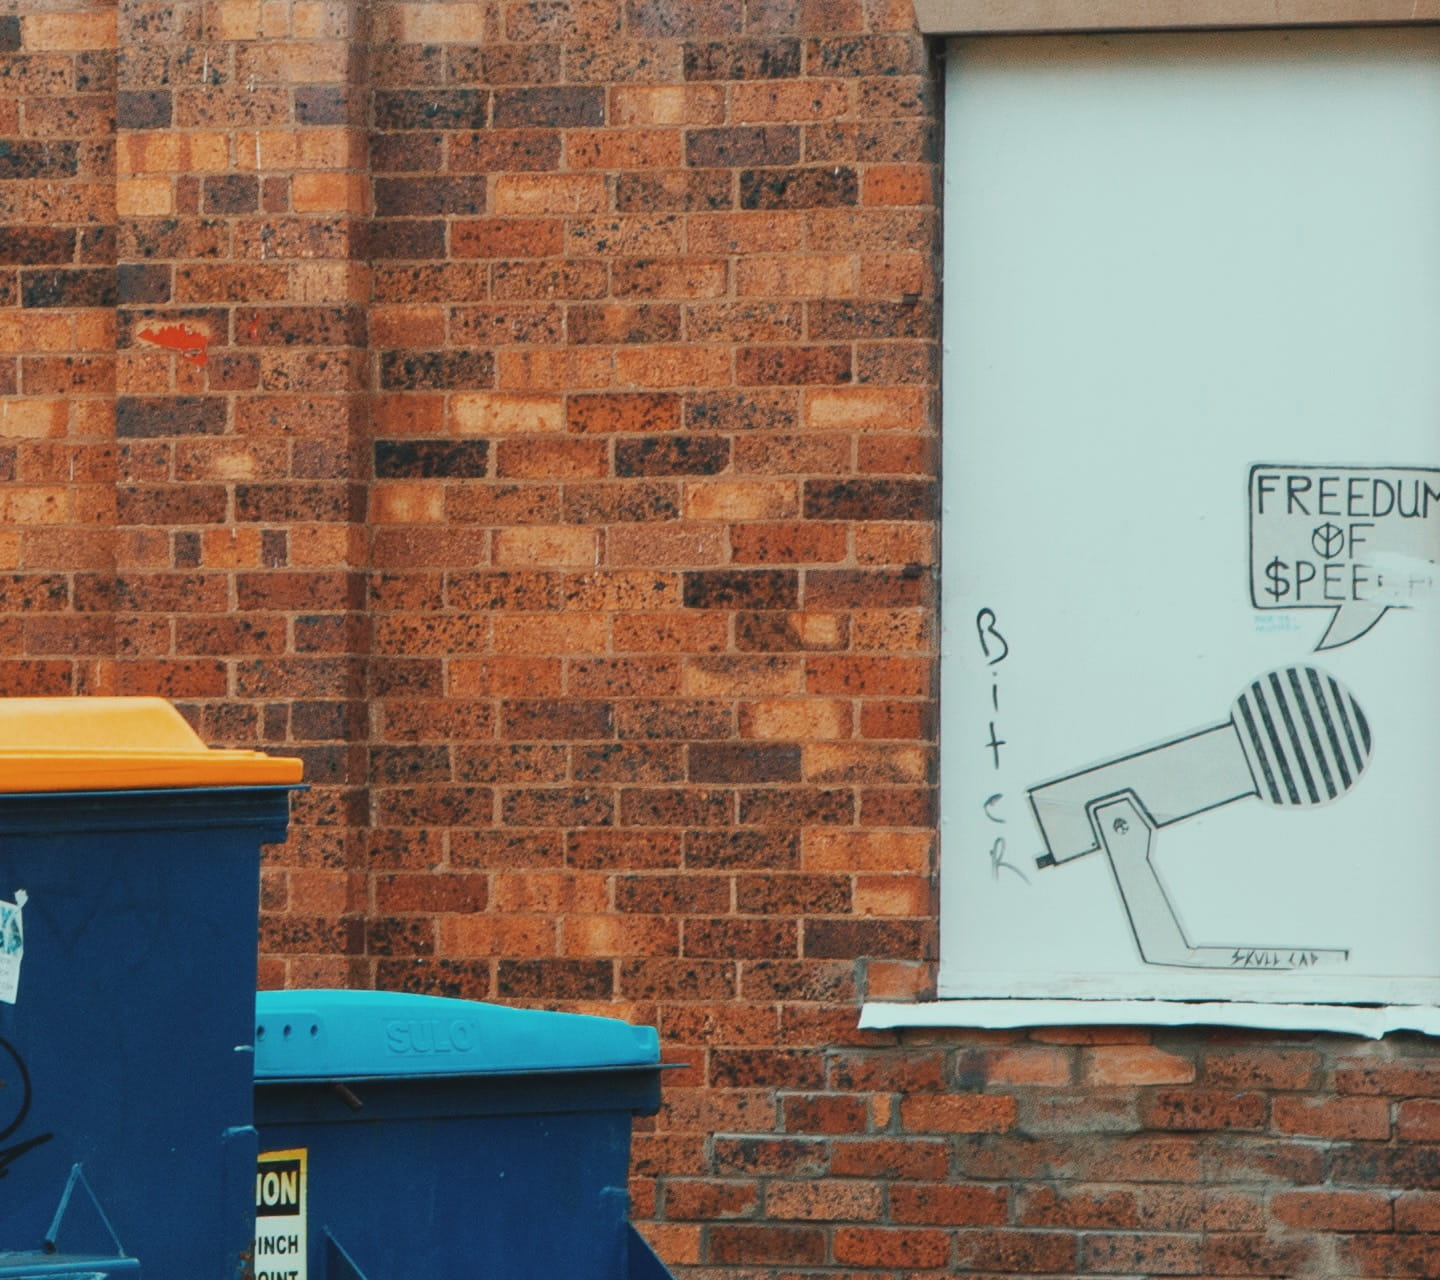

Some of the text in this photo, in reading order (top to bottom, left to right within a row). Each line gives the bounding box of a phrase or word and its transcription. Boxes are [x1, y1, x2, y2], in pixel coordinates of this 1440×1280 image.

[1263, 556, 1434, 602] $PEE
[385, 1019, 474, 1054] SULO
[255, 1234, 300, 1256] INCH
